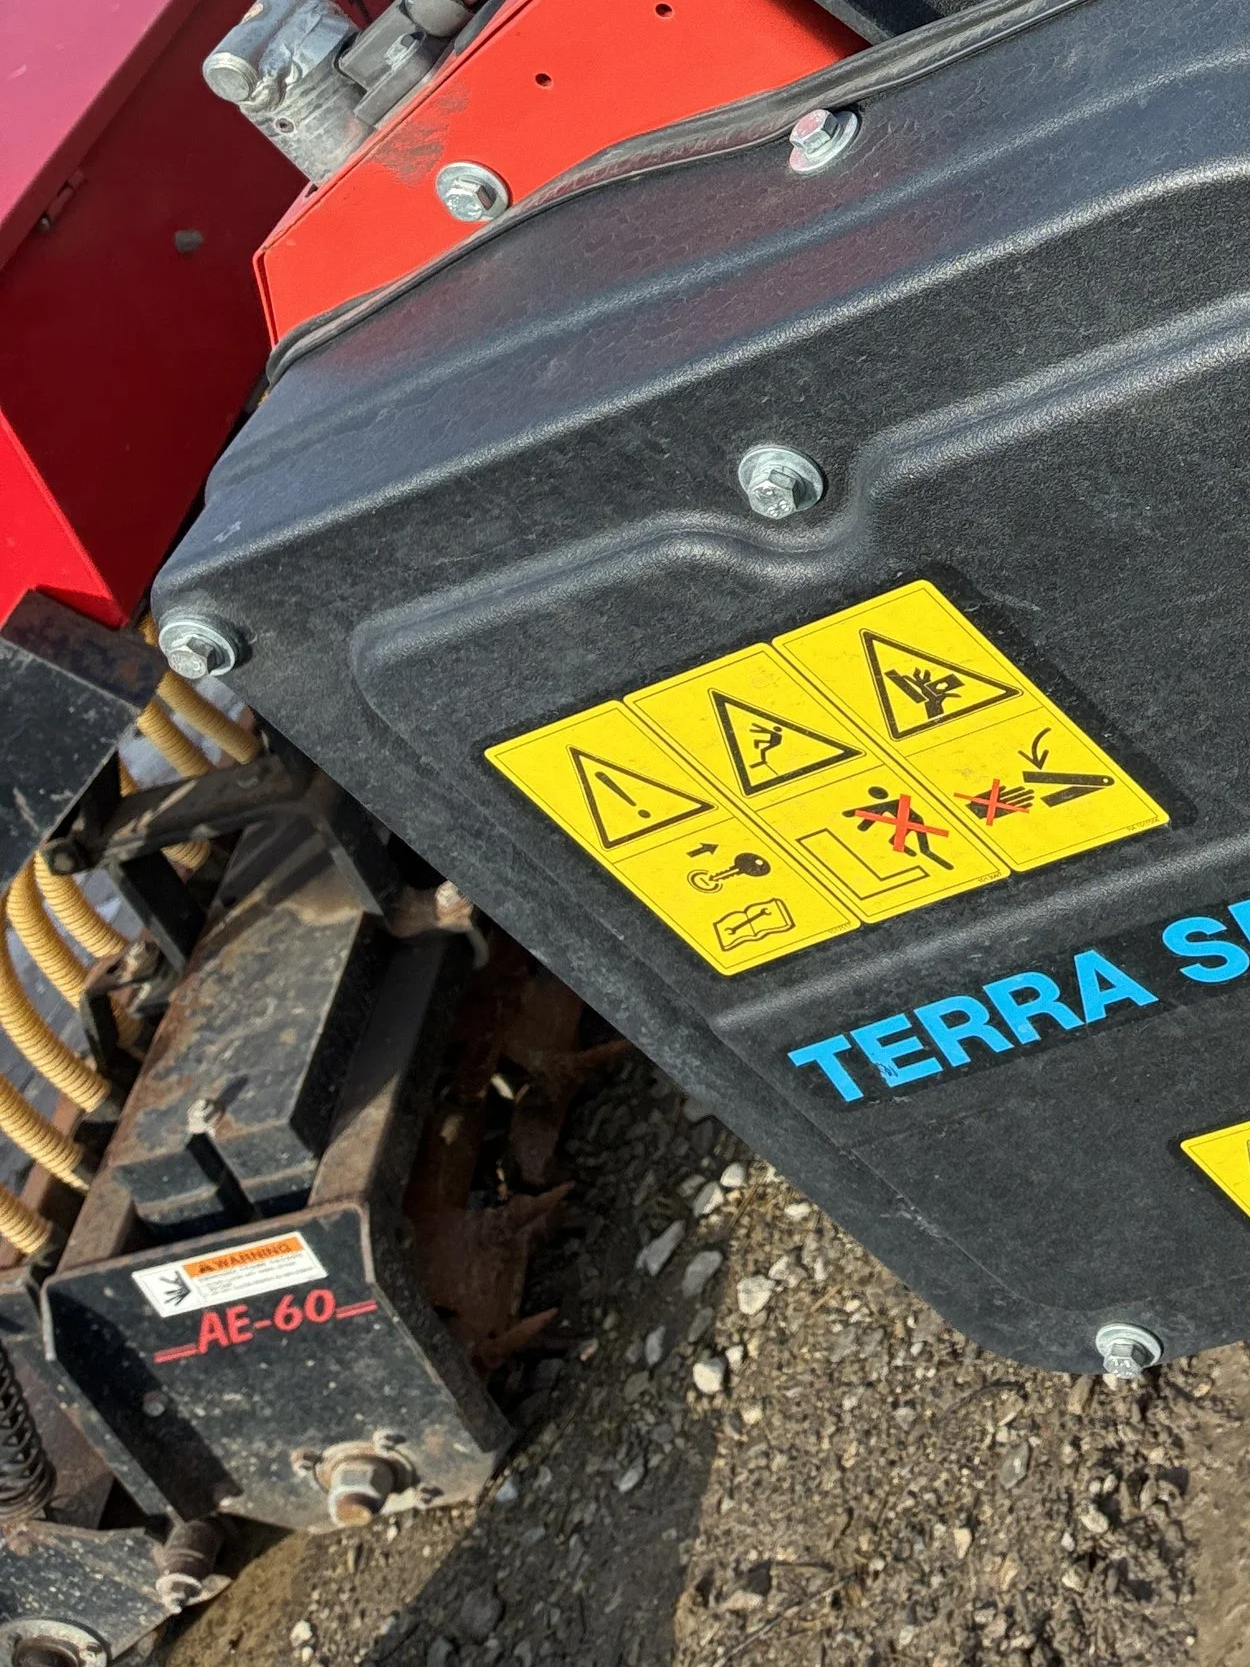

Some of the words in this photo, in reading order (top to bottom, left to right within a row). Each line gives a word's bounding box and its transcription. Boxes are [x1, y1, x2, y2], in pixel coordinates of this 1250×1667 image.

[787, 949, 1159, 1103] TERRA
[214, 1244, 294, 1269] WARNING
[195, 1288, 336, 1355] AE-60
